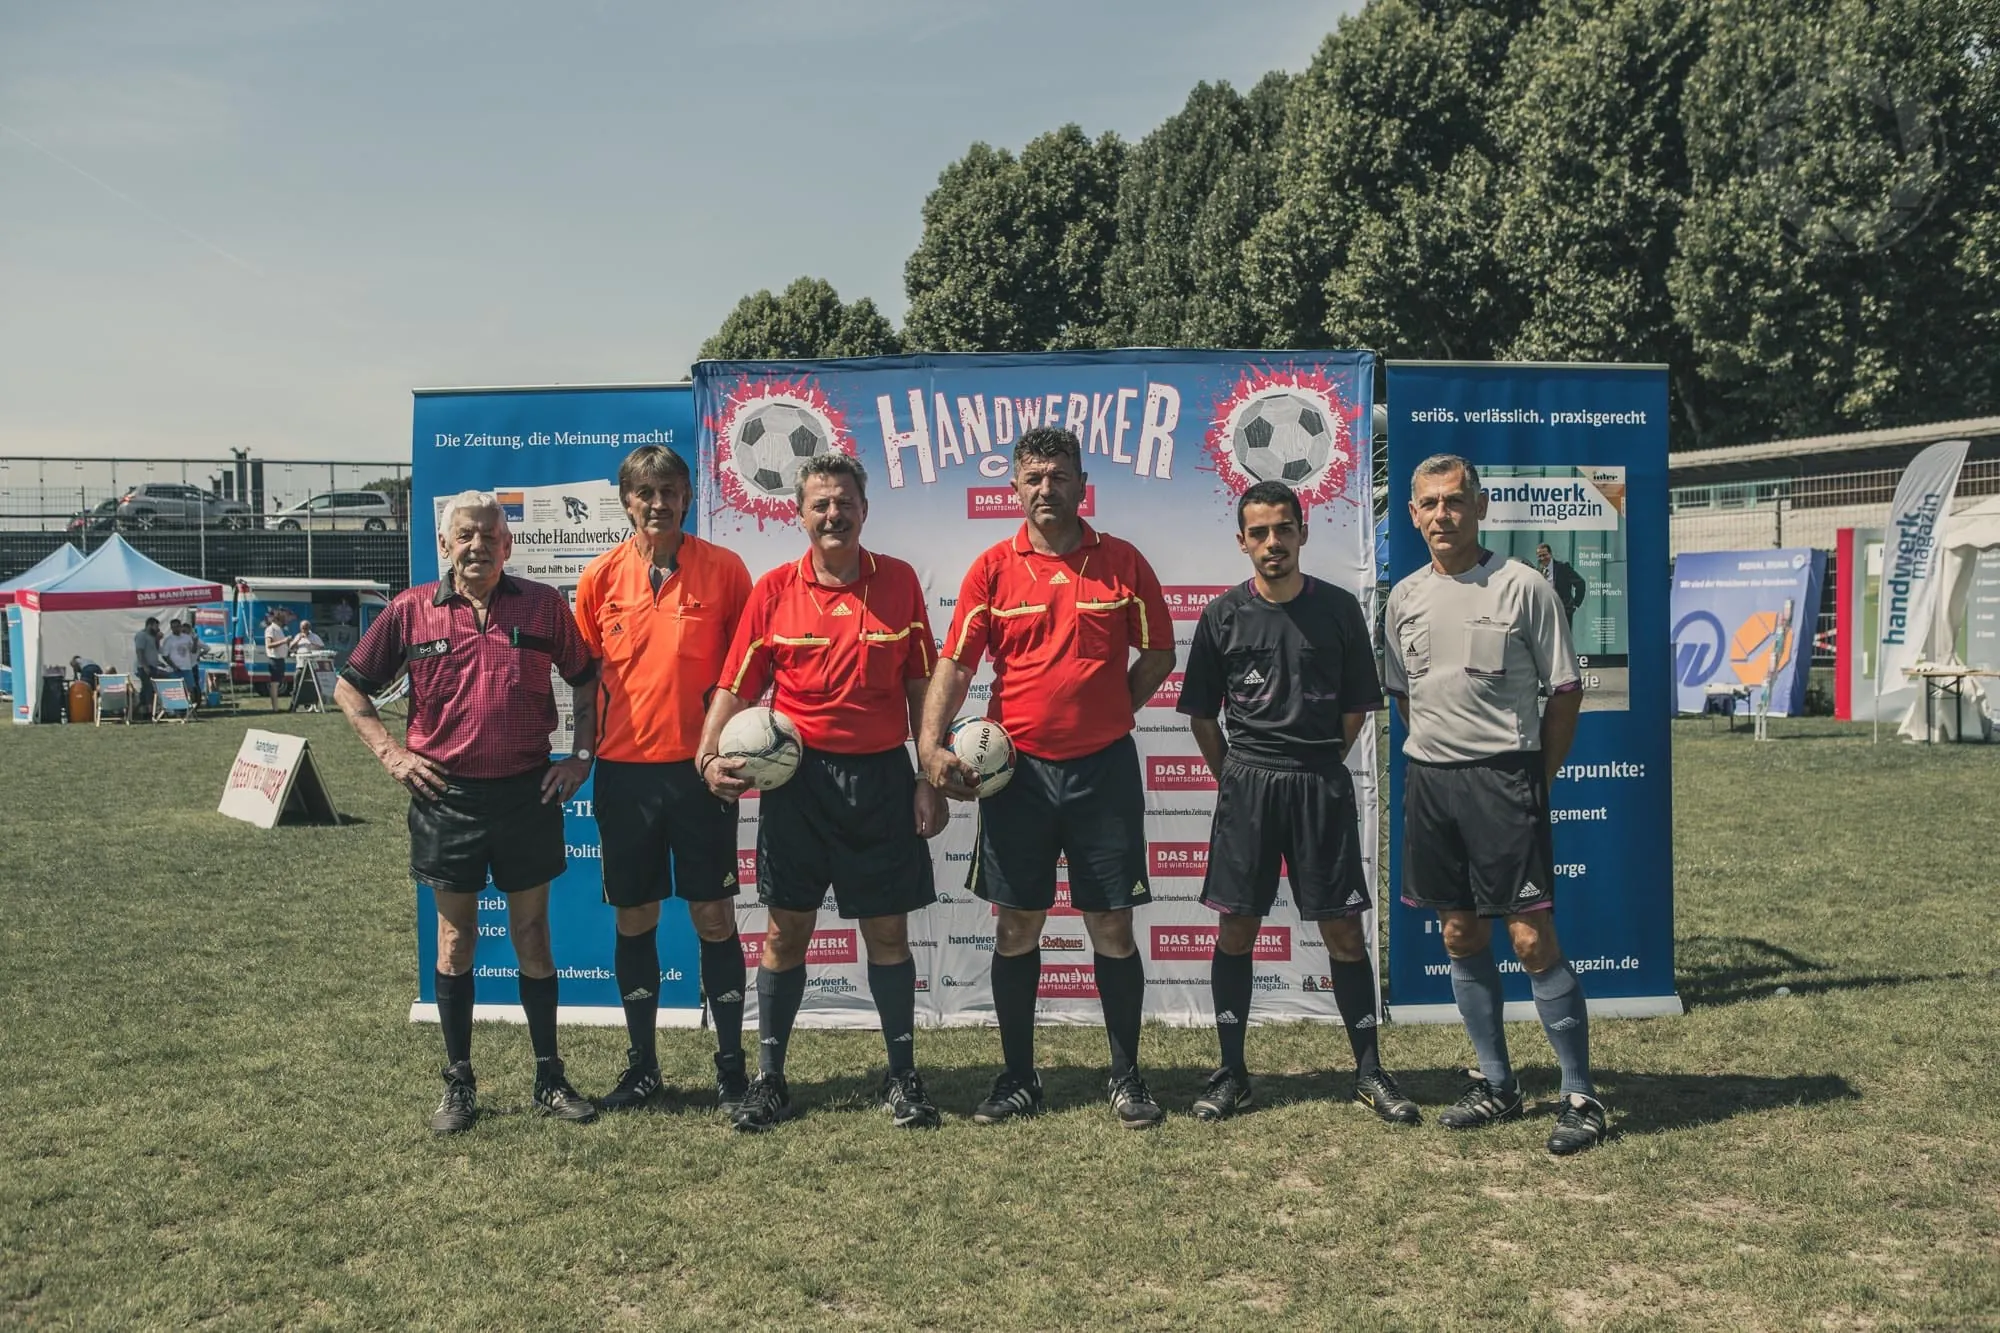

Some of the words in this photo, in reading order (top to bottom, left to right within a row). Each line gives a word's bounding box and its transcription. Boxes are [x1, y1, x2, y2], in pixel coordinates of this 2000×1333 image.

[1411, 408, 1459, 423] seriös.
[1464, 409, 1545, 424] verlässlich.
[1550, 409, 1647, 426] praxisgerecht
[435, 433, 461, 448] Die
[464, 433, 524, 449] Zeitung,
[528, 431, 551, 446] die
[554, 430, 620, 448] Meinung
[623, 429, 673, 444] macht!
[979, 455, 1009, 478] C
[975, 495, 1002, 505] DAS
[1530, 499, 1602, 520] magazin
[1912, 493, 1941, 579] magazin
[527, 565, 546, 574] Bund
[549, 565, 562, 574] hilft
[565, 565, 576, 573] bei
[1882, 511, 1920, 645] handwerk
[137, 591, 156, 600] DAS
[977, 727, 991, 752] JAKO
[1155, 765, 1186, 775] DAS
[1190, 765, 1213, 775] HA
[1555, 761, 1646, 781] erpunkte:
[1550, 806, 1607, 823] gement
[564, 844, 602, 858] Politi
[1157, 850, 1188, 861] DAS
[738, 858, 755, 869] AS
[1553, 863, 1586, 878] orge
[477, 896, 507, 911] rieb
[477, 923, 507, 937] vice
[741, 941, 758, 952] AS
[1041, 936, 1083, 949] Rothaus
[1159, 934, 1190, 945] DAS
[820, 984, 857, 993] magazin
